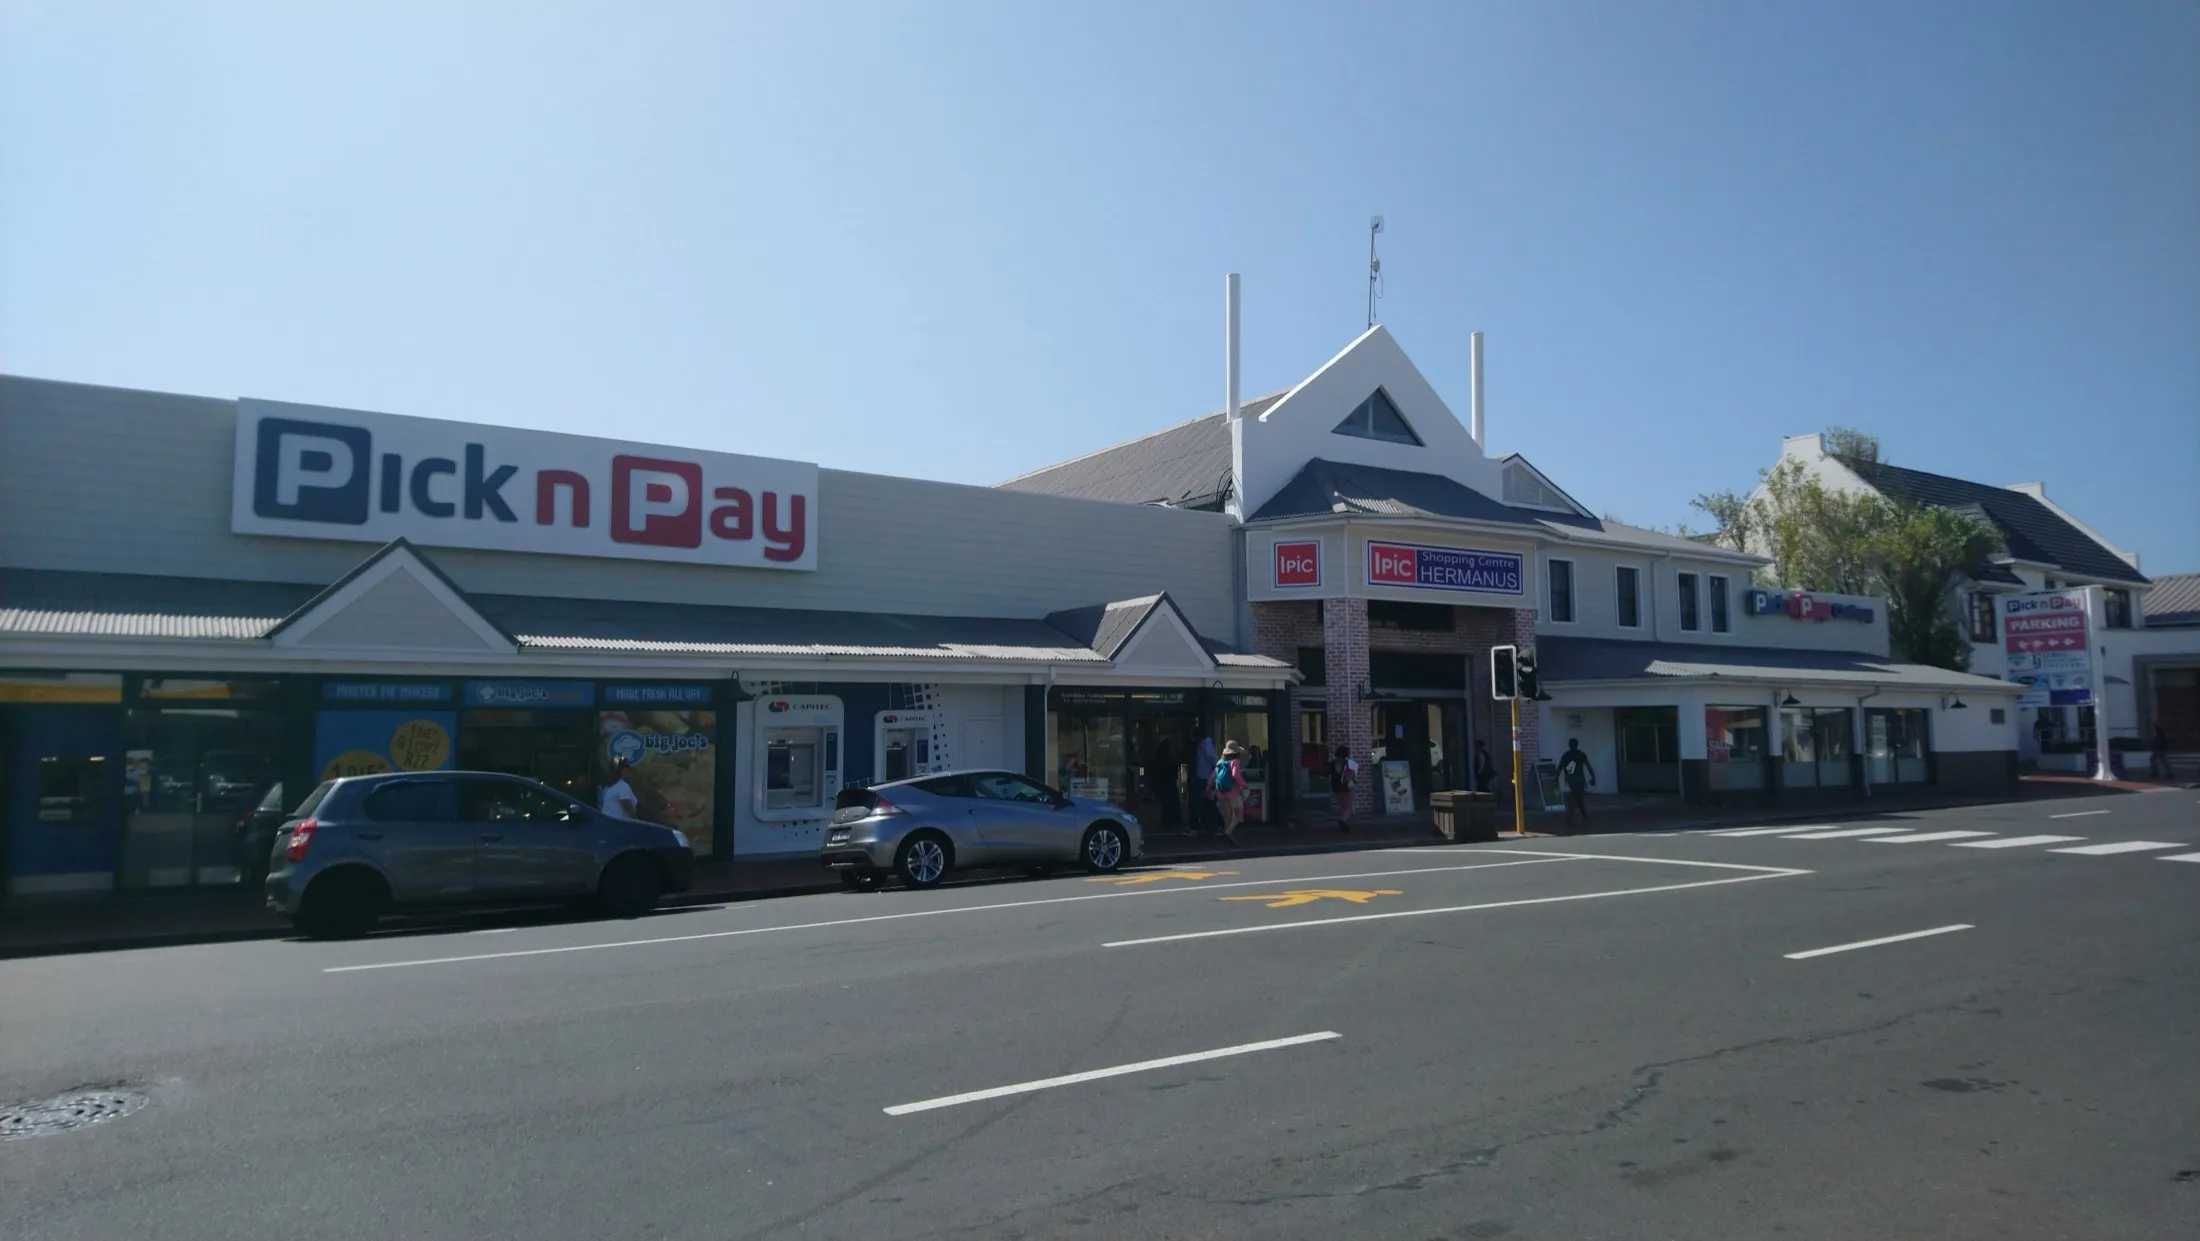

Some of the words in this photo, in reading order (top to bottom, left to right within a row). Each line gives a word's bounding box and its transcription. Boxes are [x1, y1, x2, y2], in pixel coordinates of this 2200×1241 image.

[253, 417, 519, 526] Pick
[536, 470, 590, 527] n
[609, 455, 806, 562] Pay
[1422, 551, 1475, 567] Shopping
[1478, 556, 1515, 569] Centre
[1420, 566, 1517, 589] HERMANUS
[2007, 599, 2038, 613] Pick
[2040, 600, 2048, 608] n
[2011, 616, 2080, 632] PARKING
[616, 688, 640, 699] MADE
[642, 688, 667, 699] FRESH
[669, 688, 683, 699] ALL
[792, 703, 832, 711] CAPITEC
[645, 733, 668, 750] big
[669, 733, 708, 751] joe's
